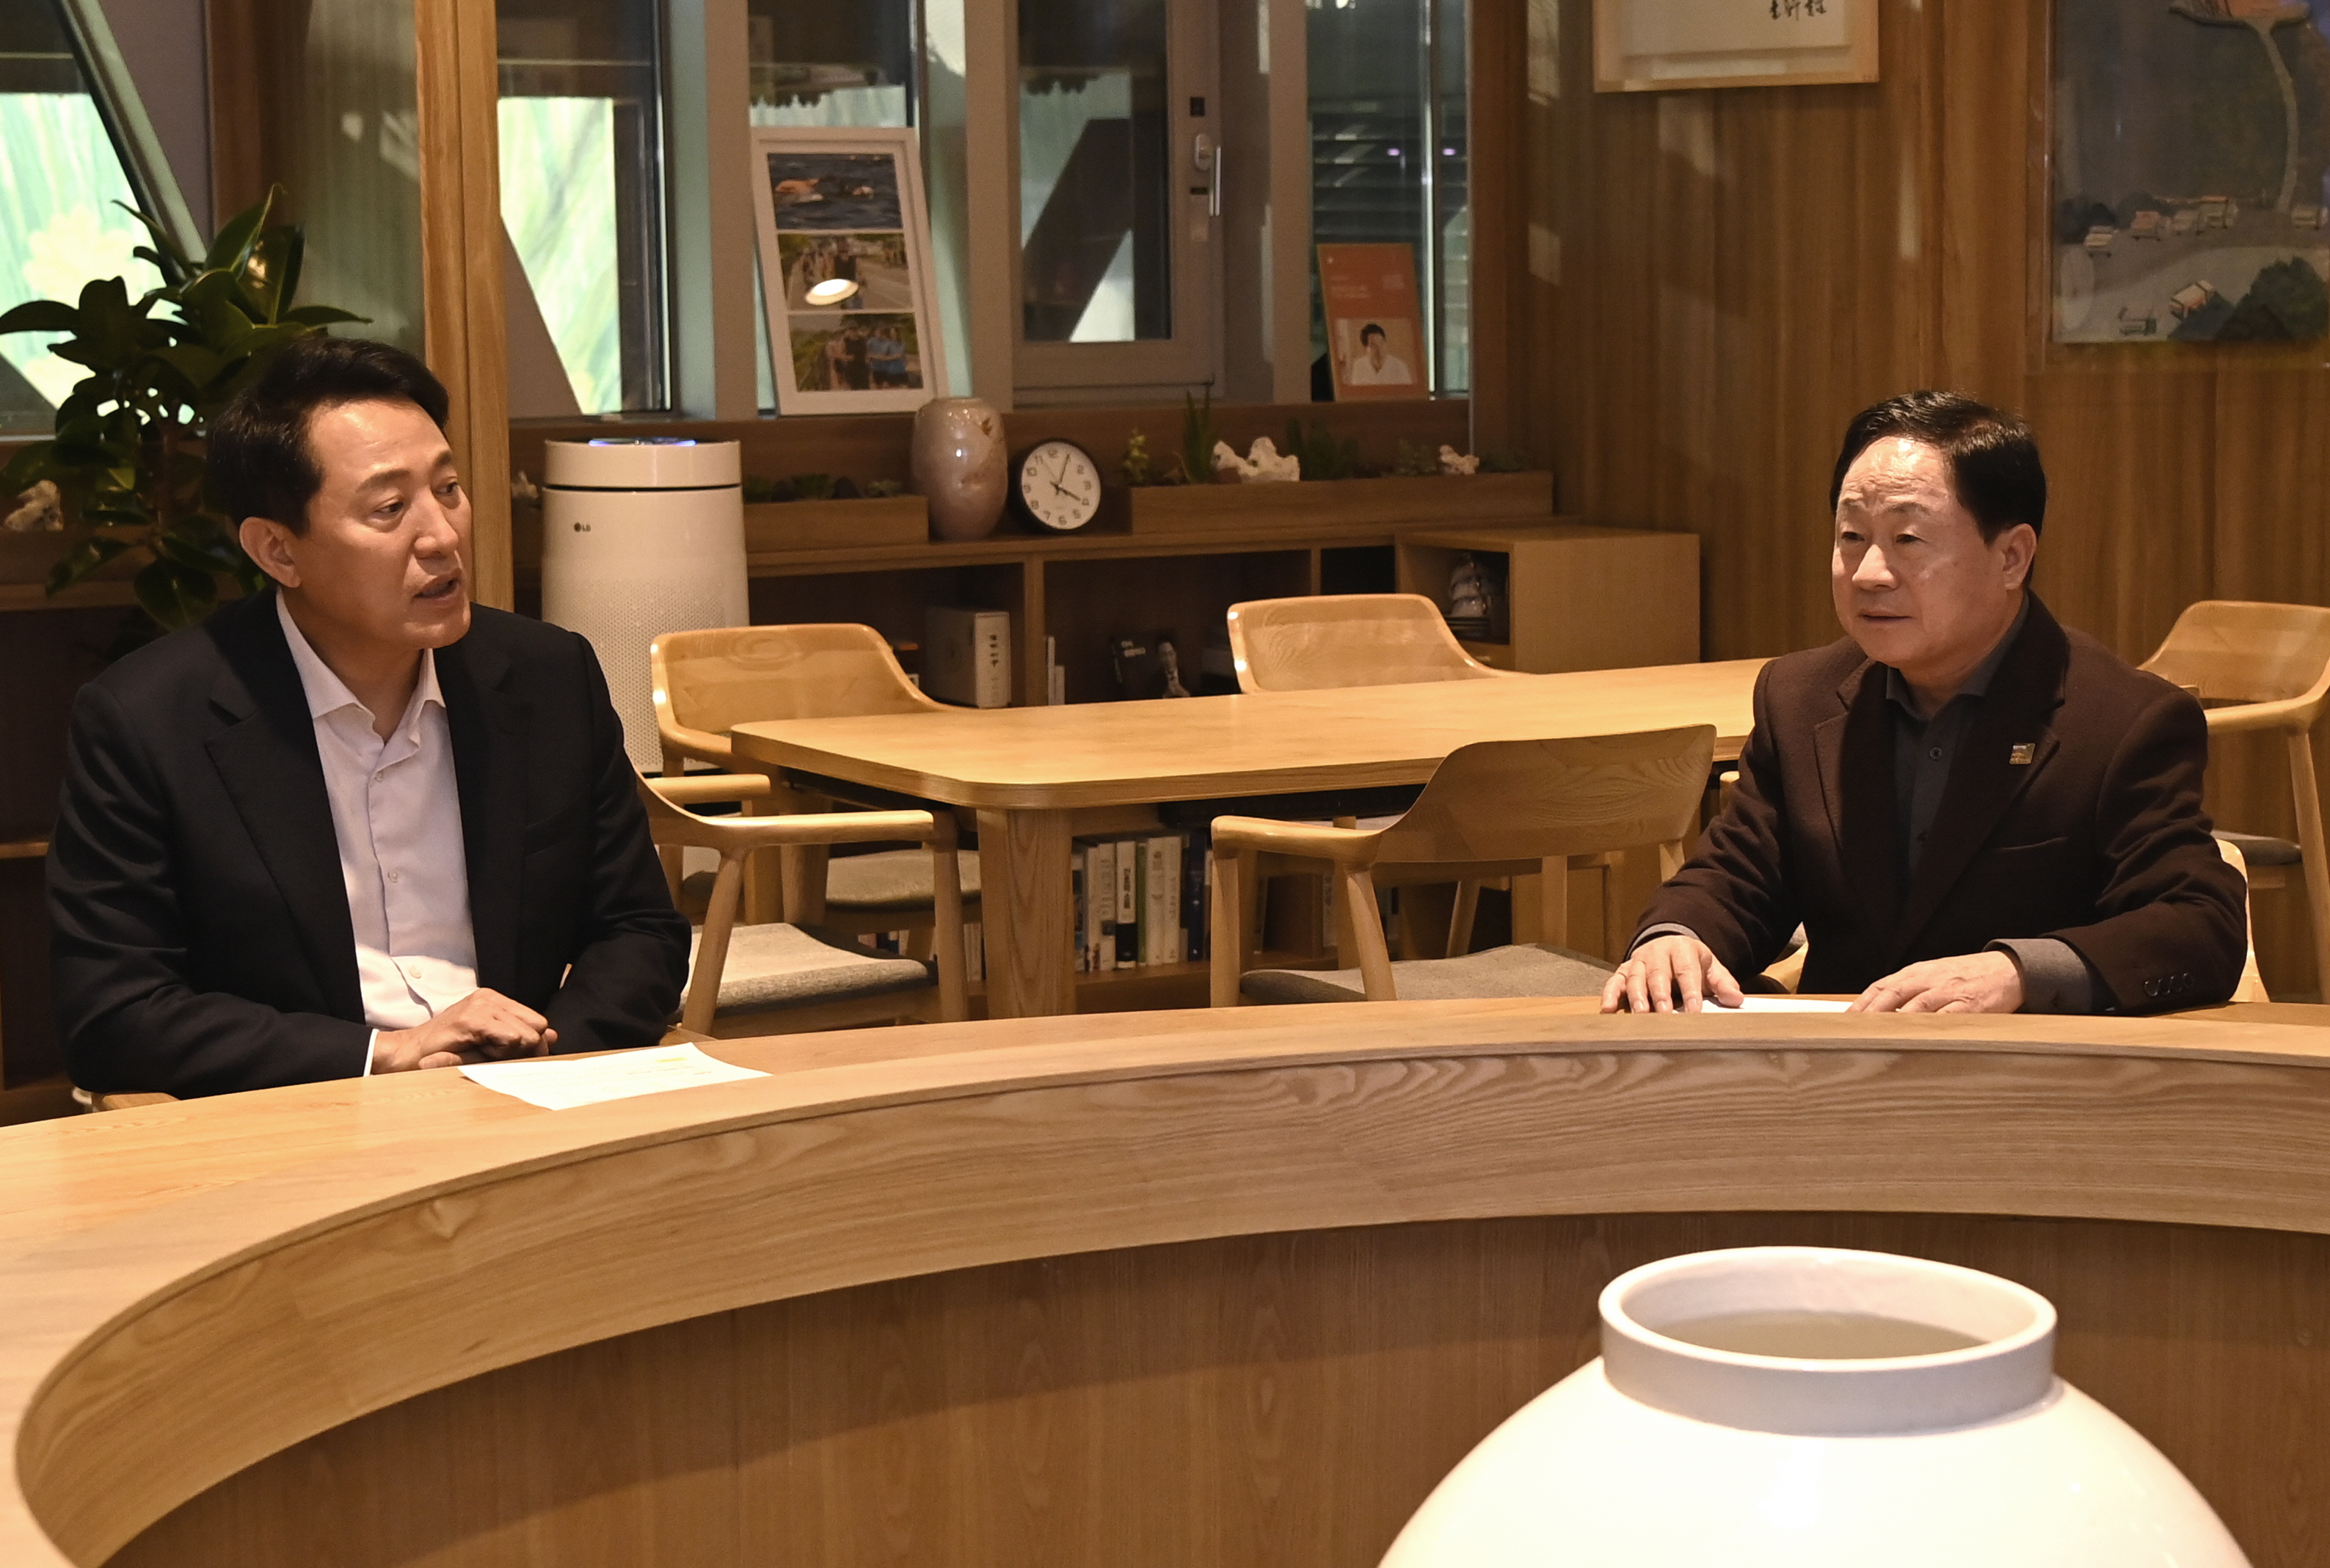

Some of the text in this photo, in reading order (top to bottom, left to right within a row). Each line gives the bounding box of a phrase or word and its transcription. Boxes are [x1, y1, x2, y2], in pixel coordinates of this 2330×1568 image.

[1047, 449, 1059, 459] 12
[1026, 467, 1038, 476] 10
[1077, 464, 1085, 475] 2
[1023, 484, 1032, 494] 9
[1083, 481, 1091, 491] 3
[1030, 500, 1039, 510] 8
[1082, 498, 1090, 506] 4
[1044, 510, 1052, 520] 7
[1058, 515, 1067, 525] 6
